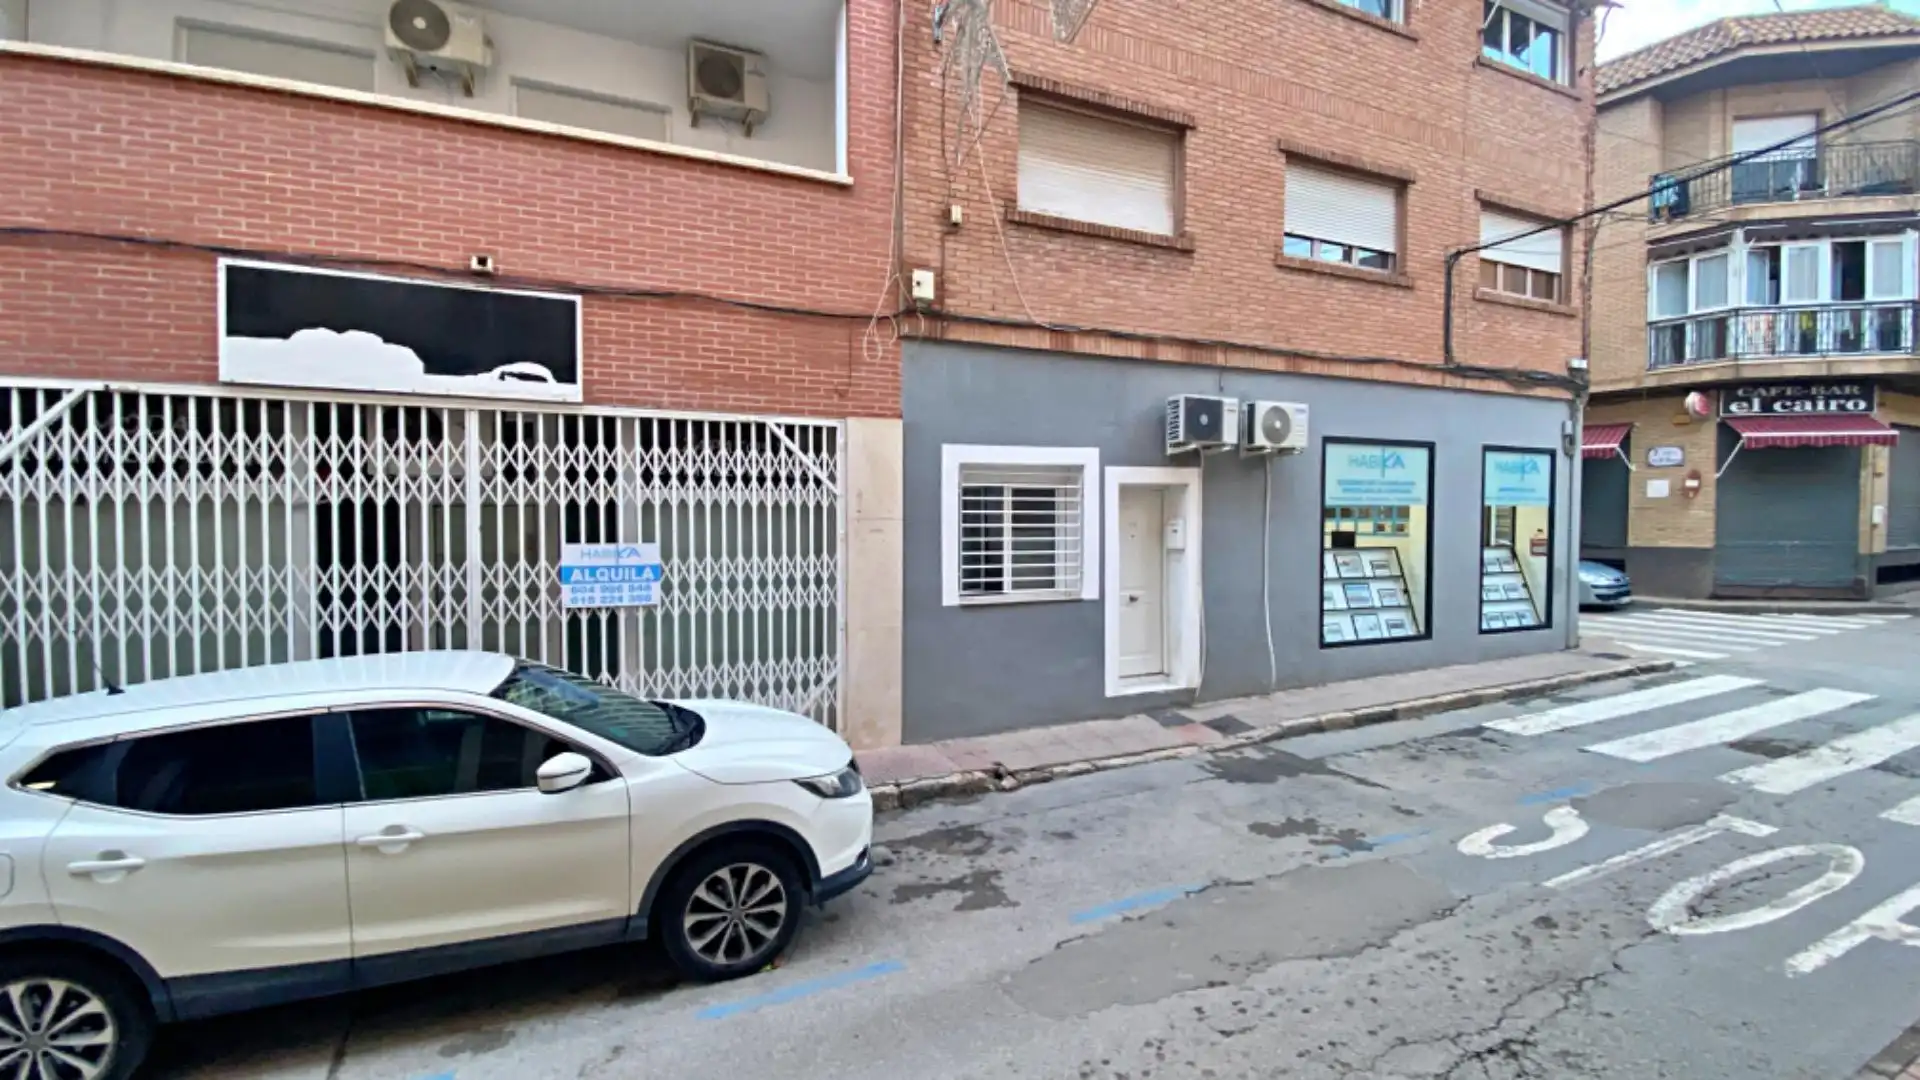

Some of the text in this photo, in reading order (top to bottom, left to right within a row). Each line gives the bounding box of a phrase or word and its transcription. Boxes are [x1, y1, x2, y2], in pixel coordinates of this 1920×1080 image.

[1728, 395, 1868, 413] el cairo
[569, 566, 656, 582] ALQUILA
